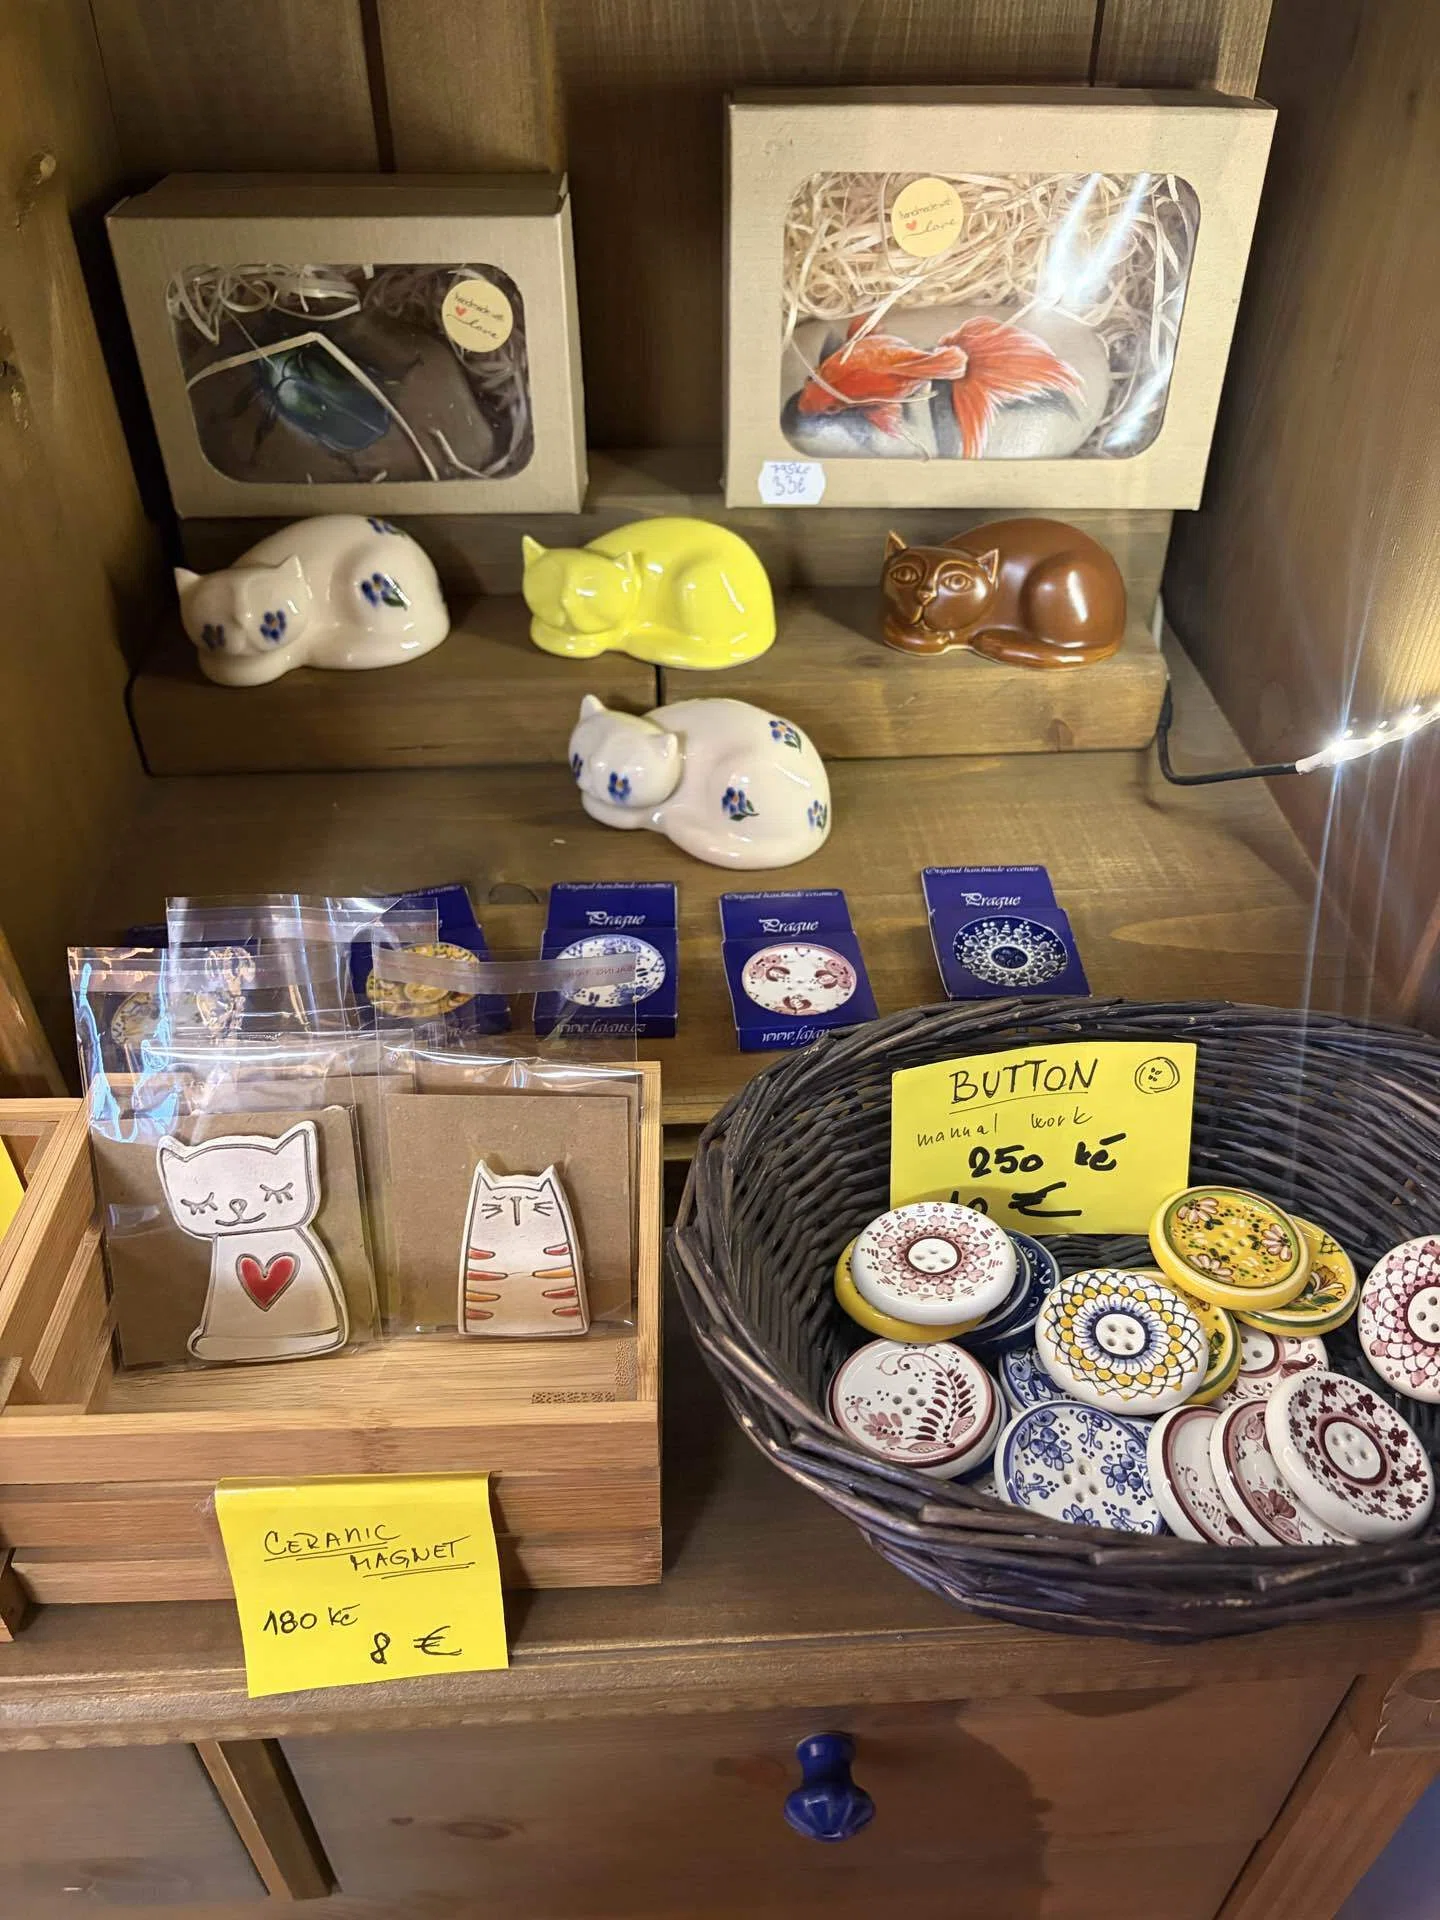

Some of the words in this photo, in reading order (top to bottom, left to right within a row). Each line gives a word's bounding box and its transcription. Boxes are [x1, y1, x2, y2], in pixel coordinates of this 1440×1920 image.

[960, 892, 1021, 911] Prague
[585, 910, 647, 930] Prague
[758, 918, 820, 937] Prague
[949, 1058, 1099, 1104] BUTTON
[917, 1112, 998, 1147] manual
[1031, 1106, 1094, 1129] work
[968, 1144, 1044, 1178] 250
[1007, 1181, 1083, 1218] €
[350, 1535, 472, 1571] MAGNET
[263, 1610, 318, 1636] 180
[370, 1632, 391, 1665] 8
[413, 1626, 463, 1657] €
